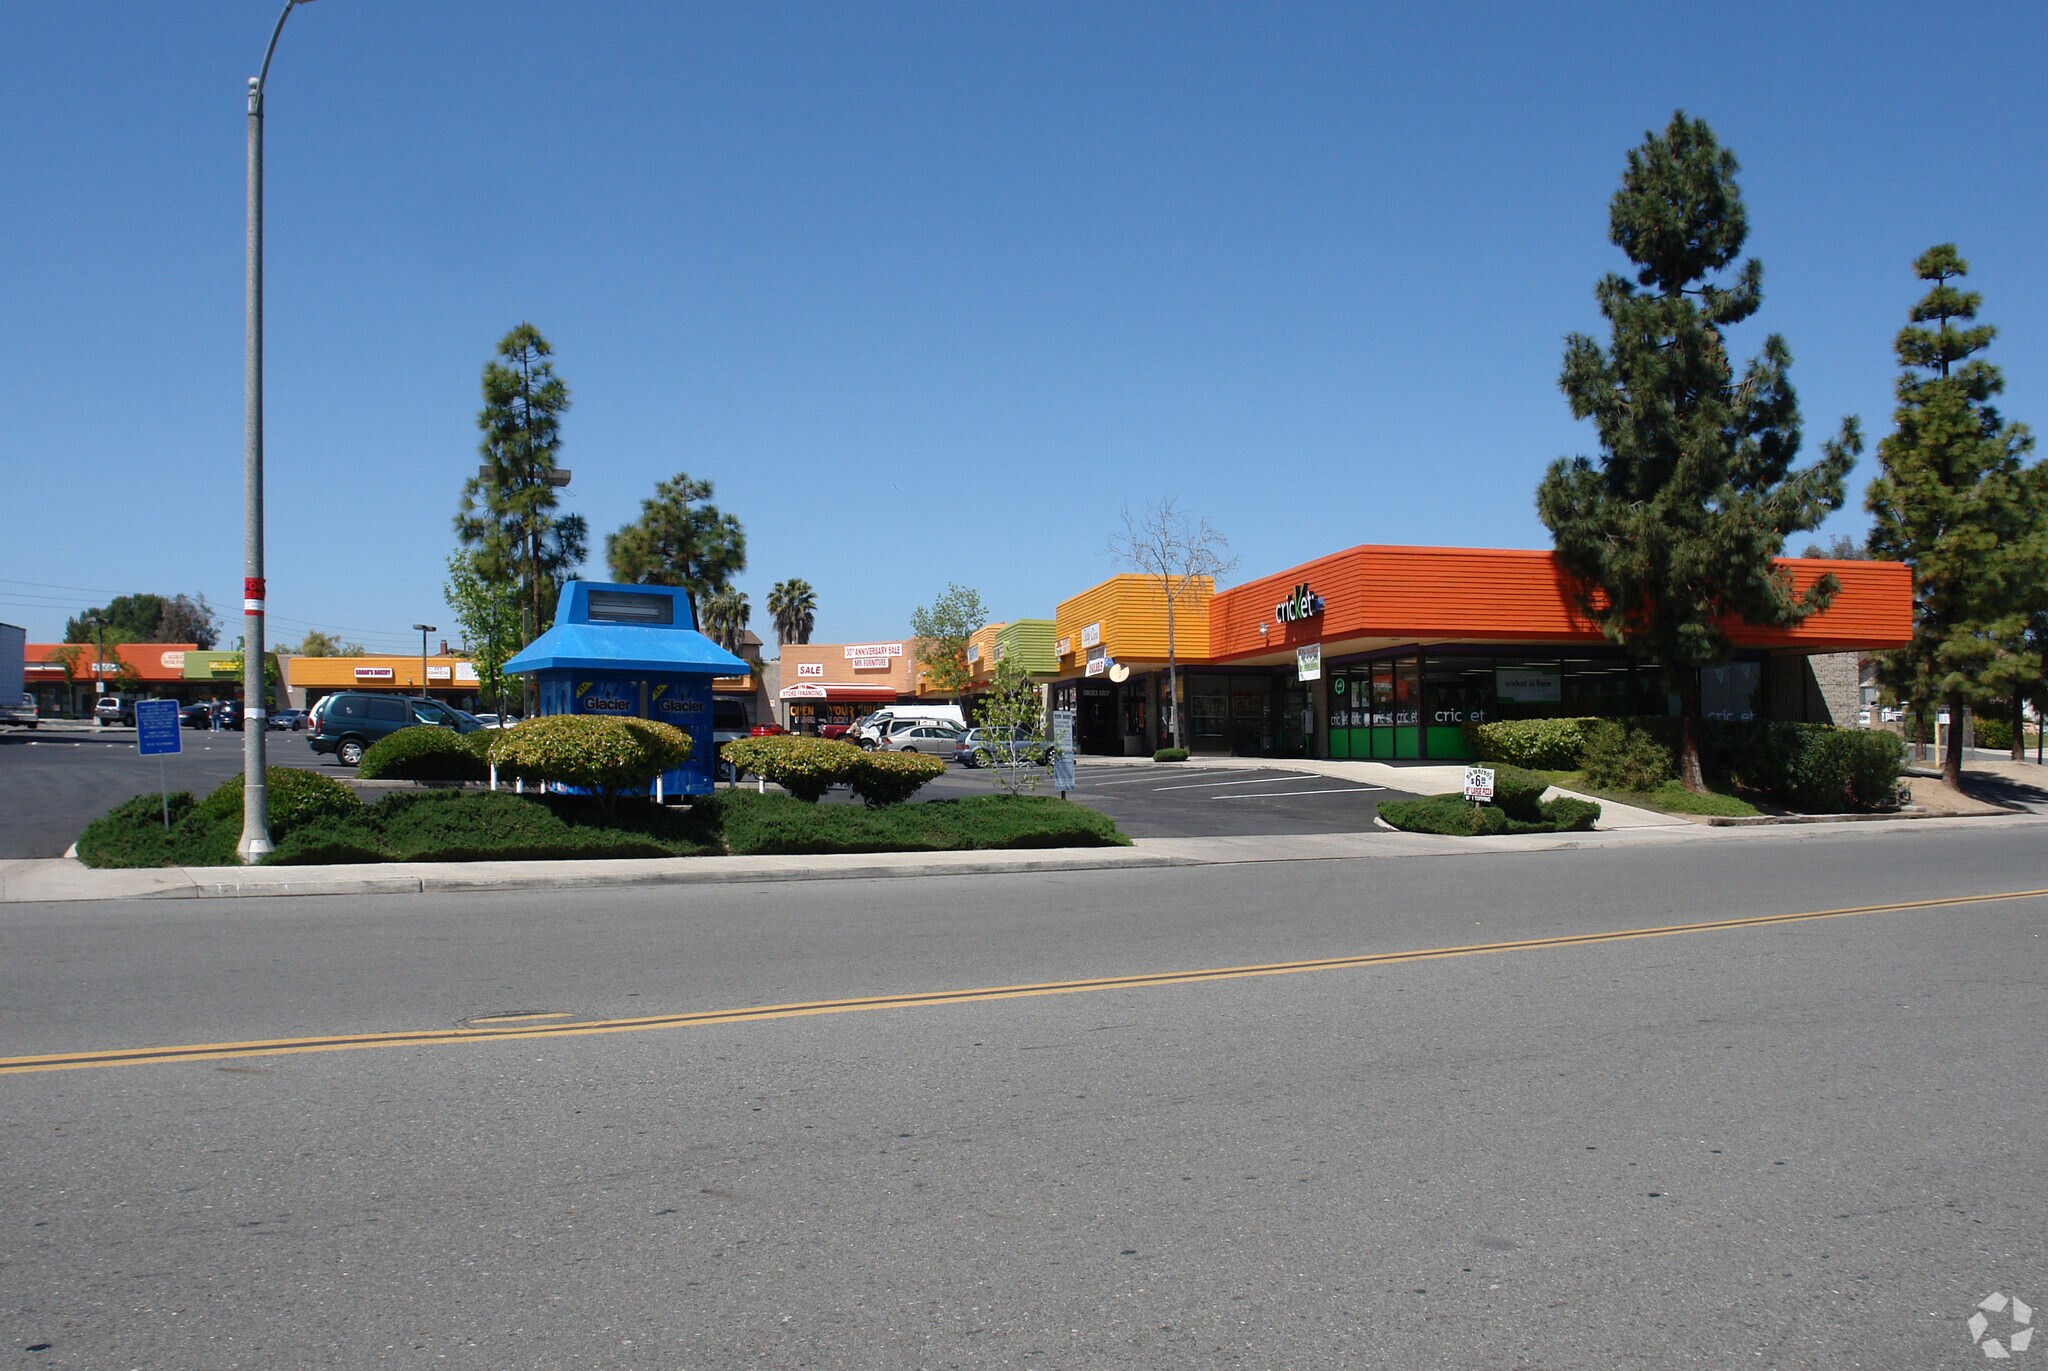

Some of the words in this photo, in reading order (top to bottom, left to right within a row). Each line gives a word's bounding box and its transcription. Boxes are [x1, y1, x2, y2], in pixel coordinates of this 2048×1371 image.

[1276, 583, 1314, 624] cricket
[855, 647, 887, 655] ANNIVERSARY
[889, 646, 900, 654] SALE
[800, 666, 821, 674] SALE
[585, 698, 630, 711] Glacier
[661, 700, 704, 712] Glacier
[1435, 708, 1486, 721] cricet
